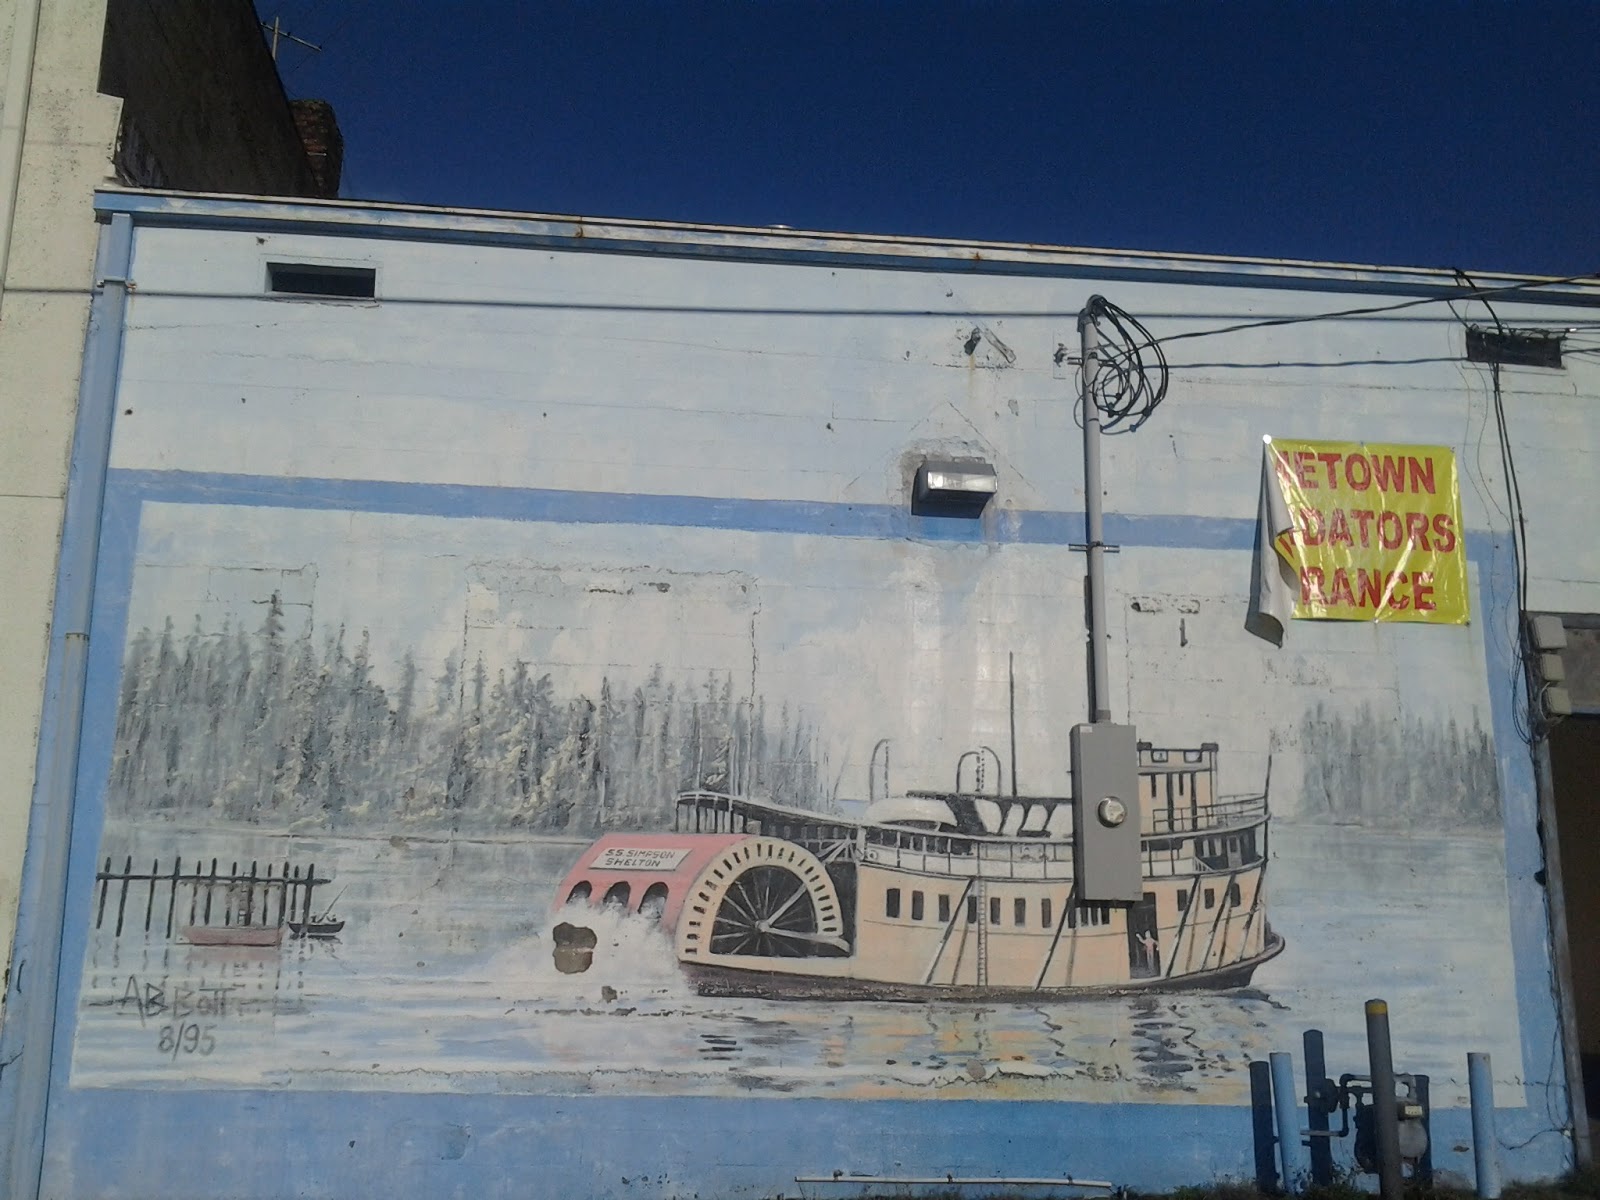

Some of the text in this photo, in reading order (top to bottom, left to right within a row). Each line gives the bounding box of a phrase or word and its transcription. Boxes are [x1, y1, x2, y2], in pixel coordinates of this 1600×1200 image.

[1300, 566, 1437, 610] RANCE
[605, 858, 661, 867] SHELTON
[626, 850, 675, 859] SIMPSON
[158, 1022, 217, 1062] 8/95
